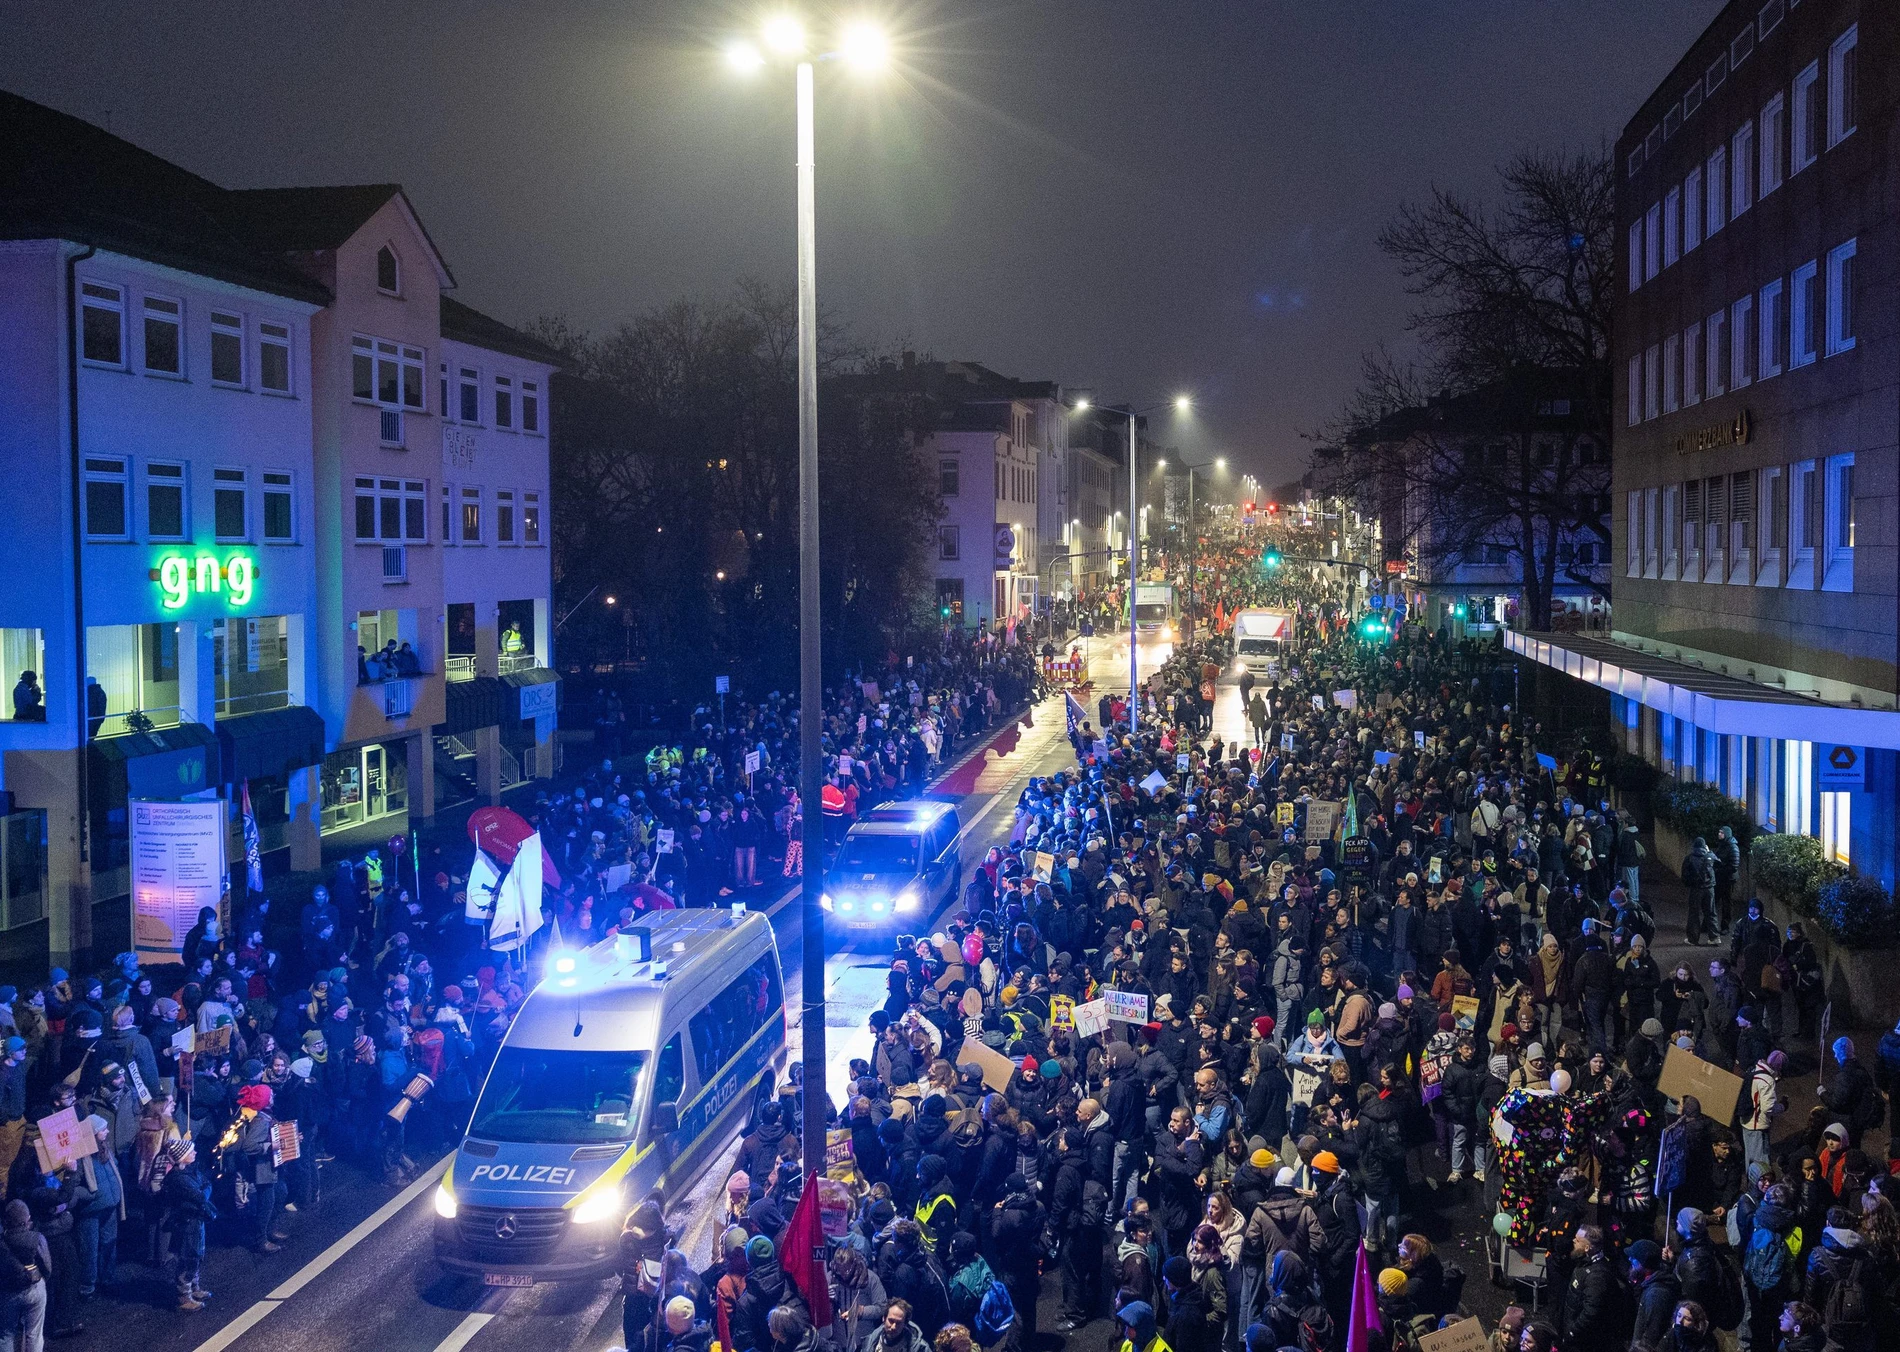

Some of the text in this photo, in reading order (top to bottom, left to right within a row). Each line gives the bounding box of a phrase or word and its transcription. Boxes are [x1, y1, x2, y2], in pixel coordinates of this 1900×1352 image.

[160, 556, 253, 609] gng
[1105, 992, 1127, 1004] NEUER
[704, 1074, 737, 1122] POLIZEI
[57, 1131, 69, 1140] LO
[59, 1138, 70, 1147] VE
[469, 1164, 577, 1186] POLIZEI
[500, 1275, 511, 1285] HP
[1430, 1341, 1448, 1352] Wir
[1452, 1331, 1477, 1344] lassen
